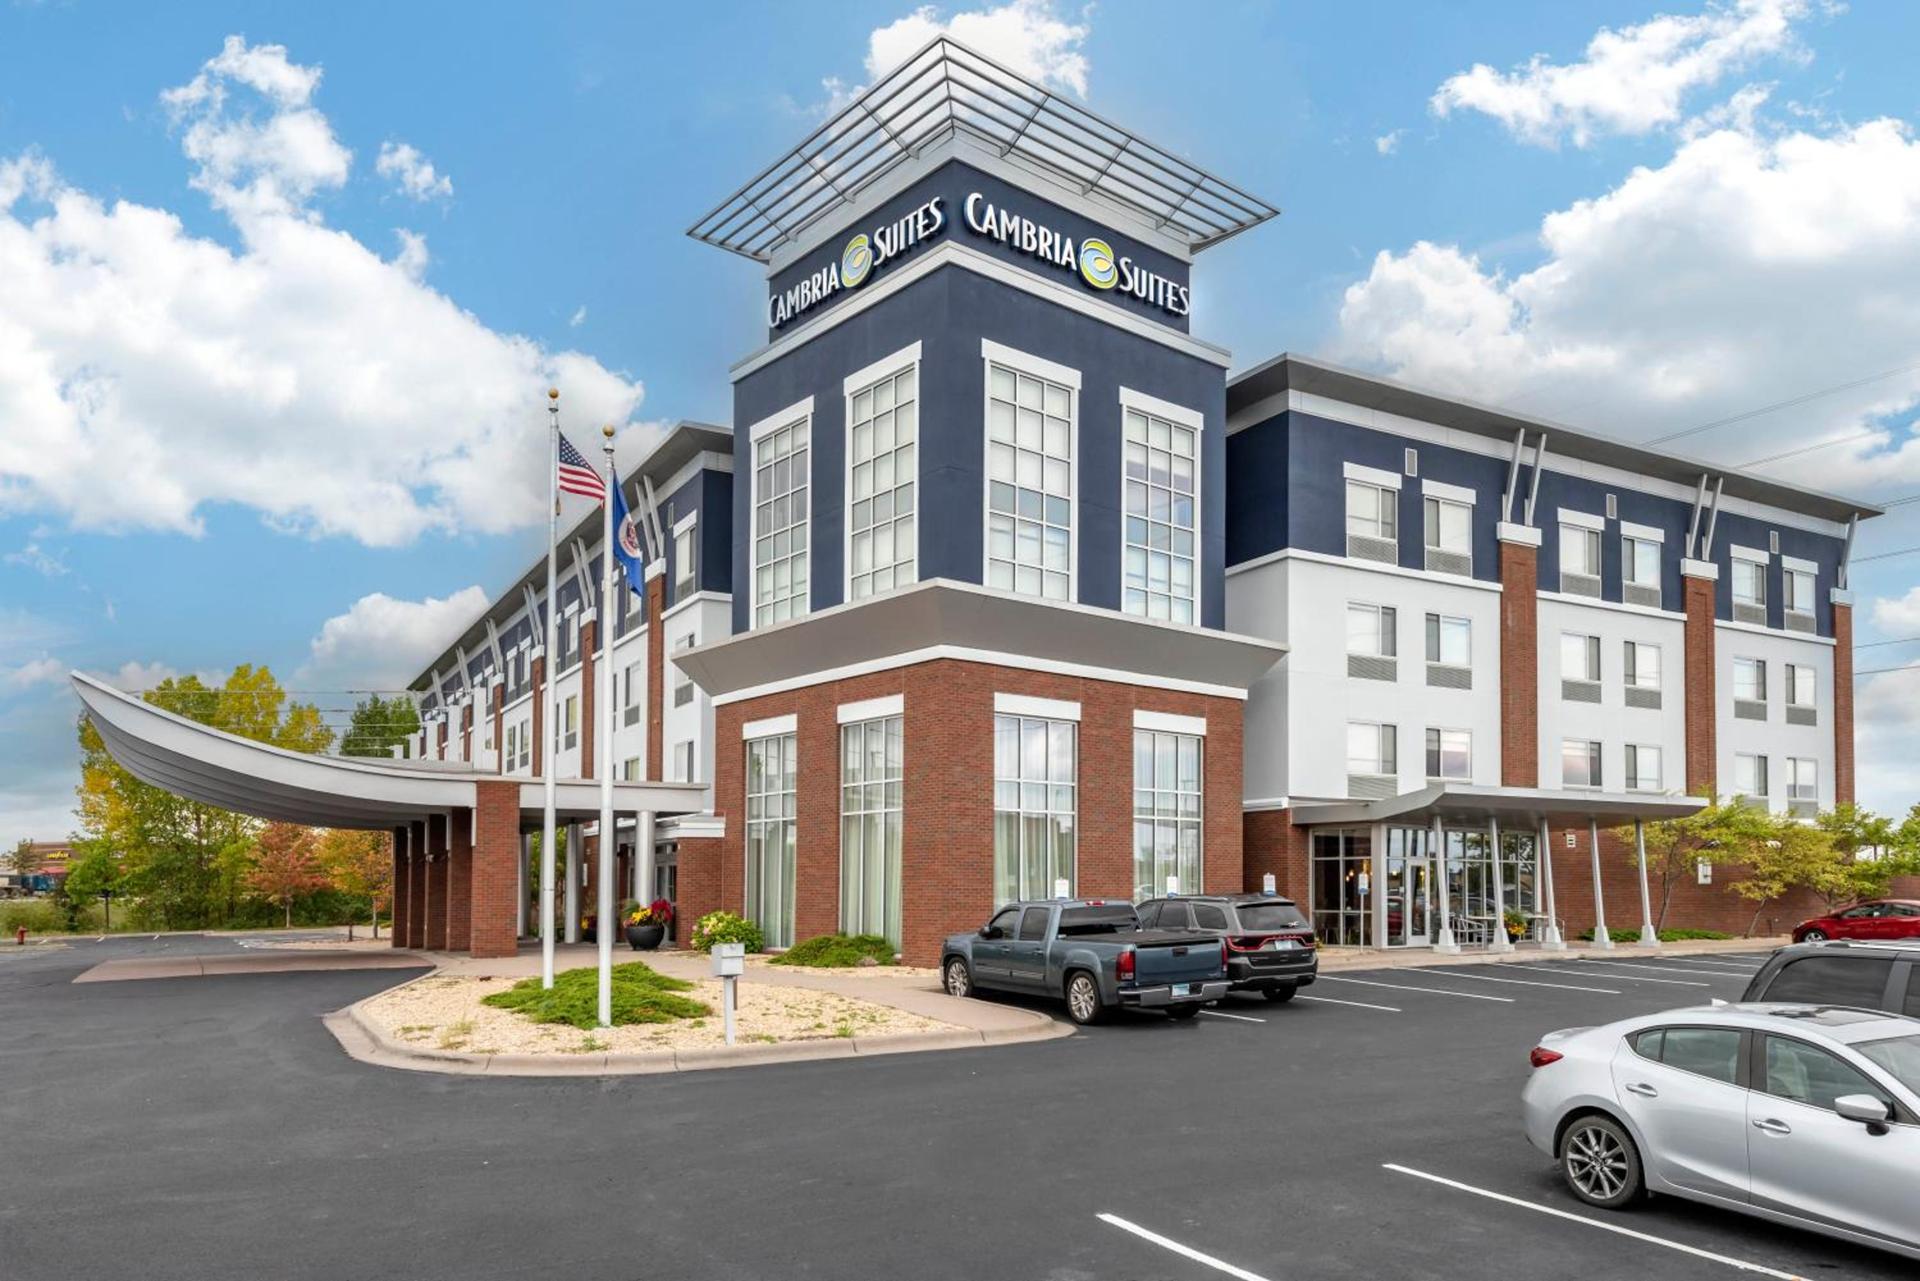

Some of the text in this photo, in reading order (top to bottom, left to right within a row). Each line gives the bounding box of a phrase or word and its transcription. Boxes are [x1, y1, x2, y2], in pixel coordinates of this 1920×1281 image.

[768, 196, 943, 328] CAMBRIA SUITES
[965, 192, 1190, 316] CAMBRIA SUITES
